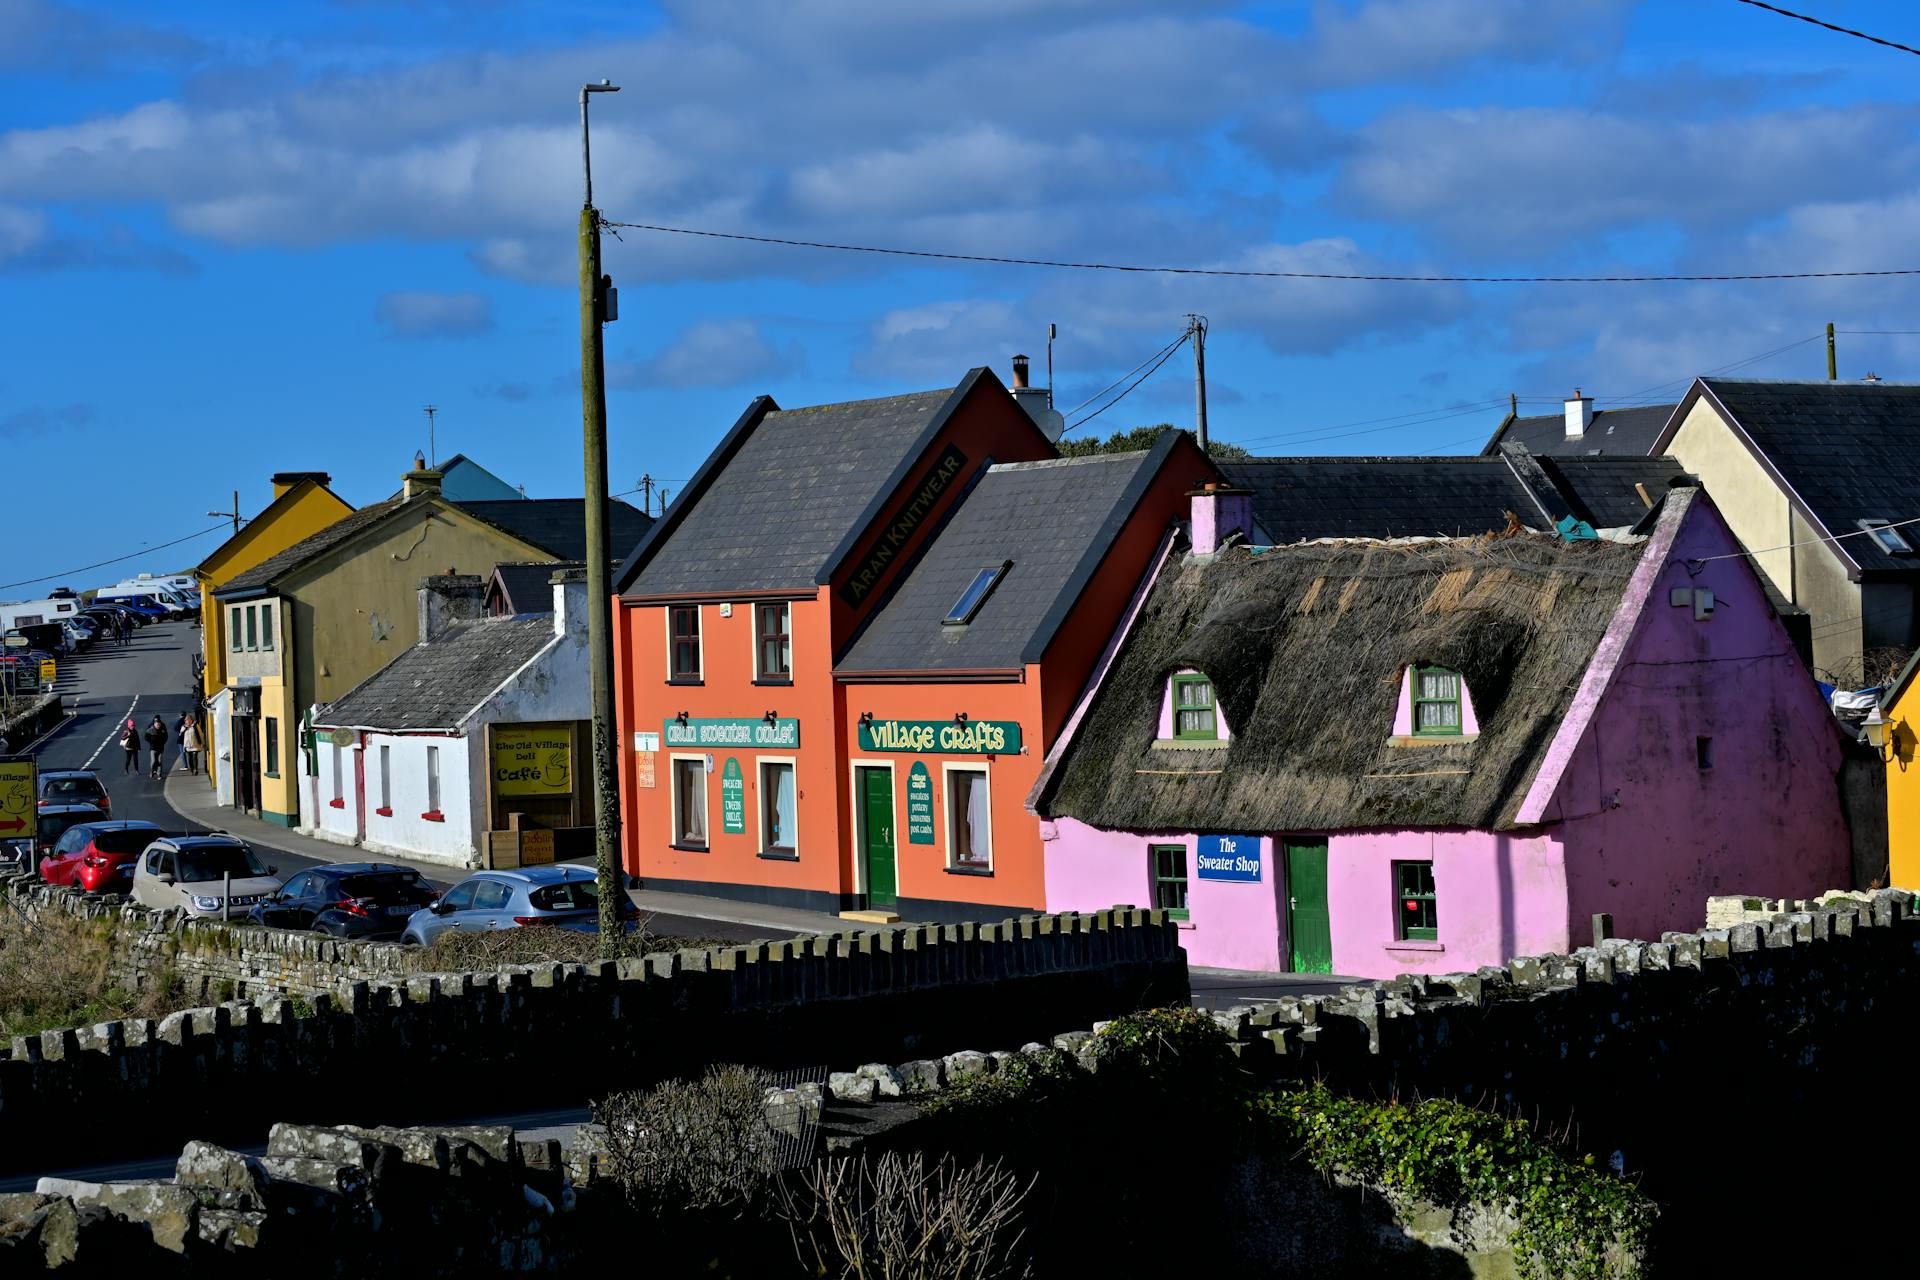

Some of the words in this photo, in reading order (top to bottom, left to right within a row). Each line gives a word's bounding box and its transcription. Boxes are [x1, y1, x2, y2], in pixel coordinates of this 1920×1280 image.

[851, 544, 892, 598] ARAN
[887, 455, 960, 546] KNITWEAR
[516, 742, 532, 750] Old
[496, 766, 542, 781] Café
[1219, 837, 1237, 853] The
[1198, 854, 1235, 871] Sweater
[1235, 855, 1260, 876] Shop
